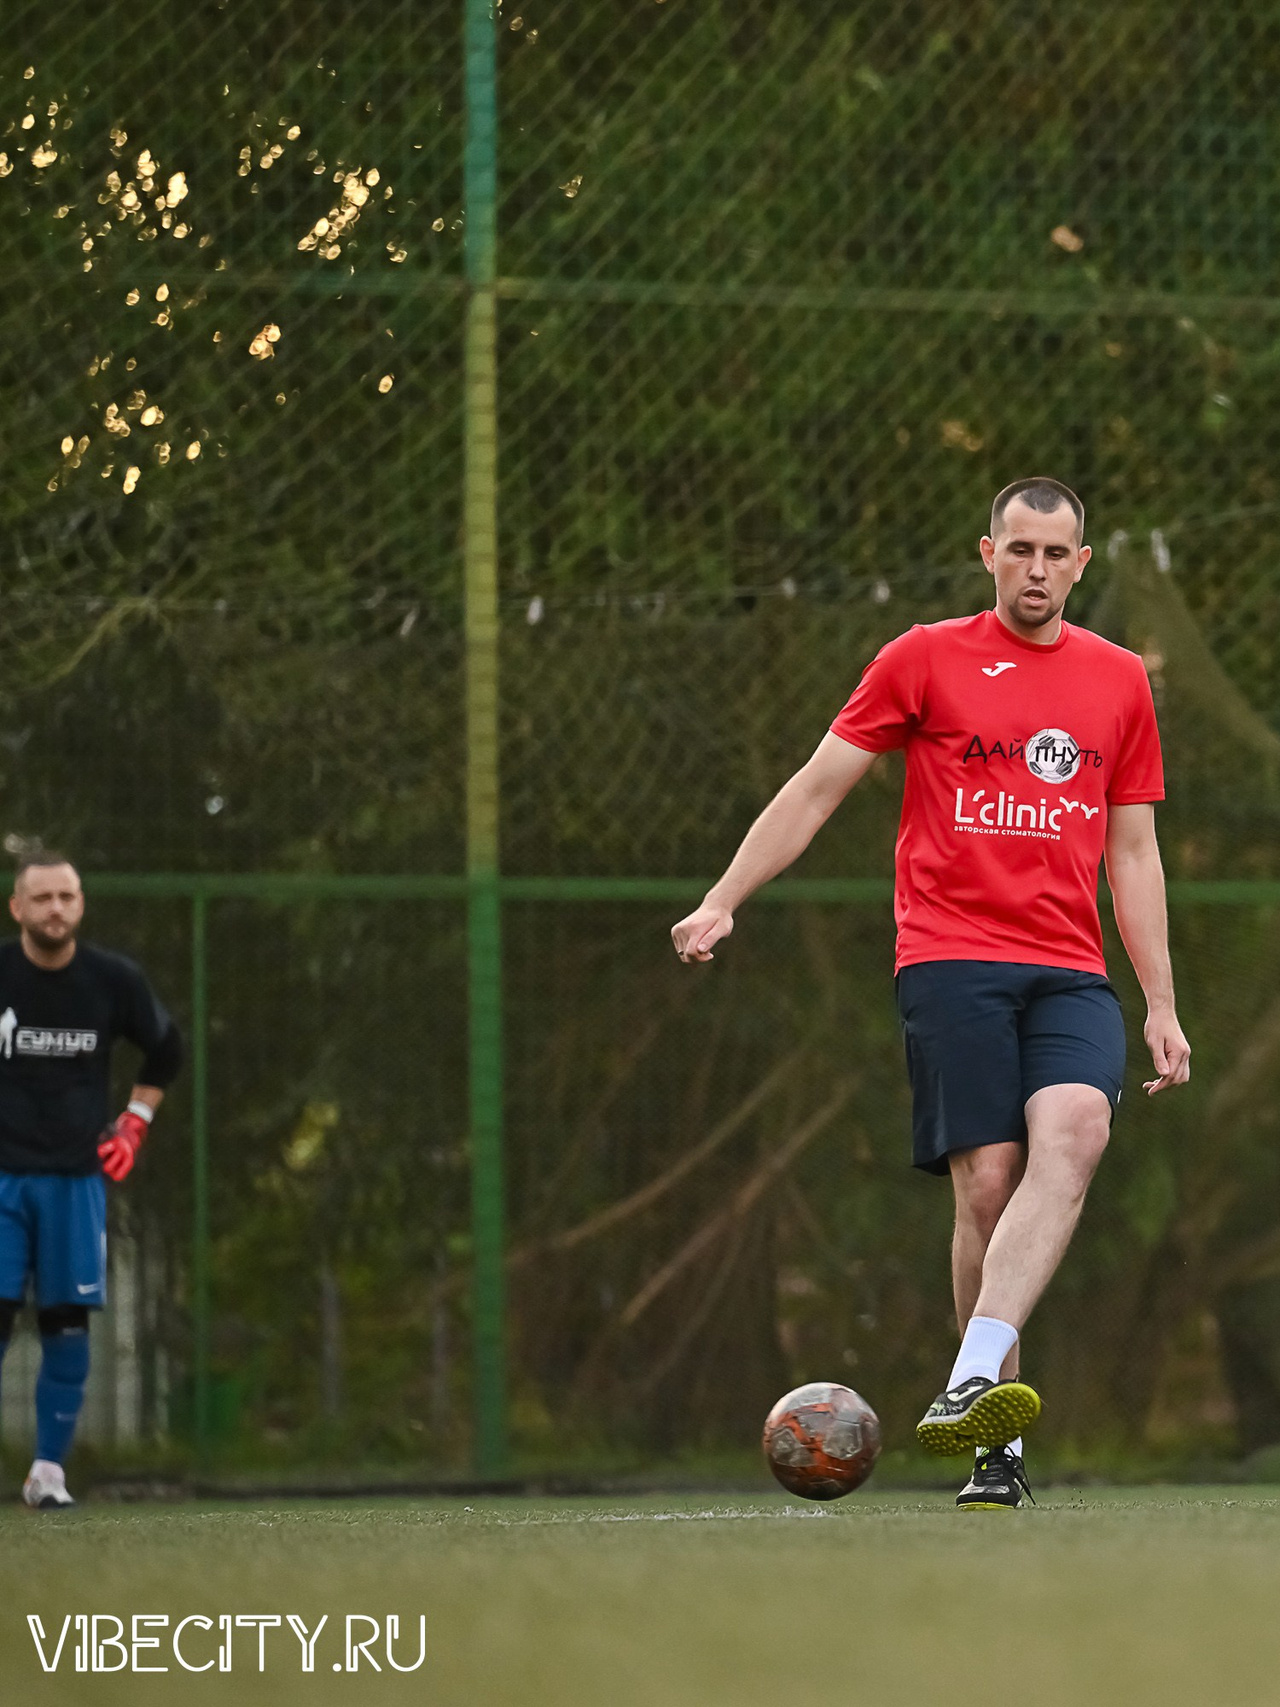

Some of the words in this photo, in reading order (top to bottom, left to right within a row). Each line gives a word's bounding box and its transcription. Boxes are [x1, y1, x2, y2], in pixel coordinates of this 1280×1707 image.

[962, 734, 1025, 765] ДАЙ
[1035, 745, 1103, 769] ПНУТЬ
[953, 825, 1000, 835] авторская
[1001, 828, 1061, 841] стоматология
